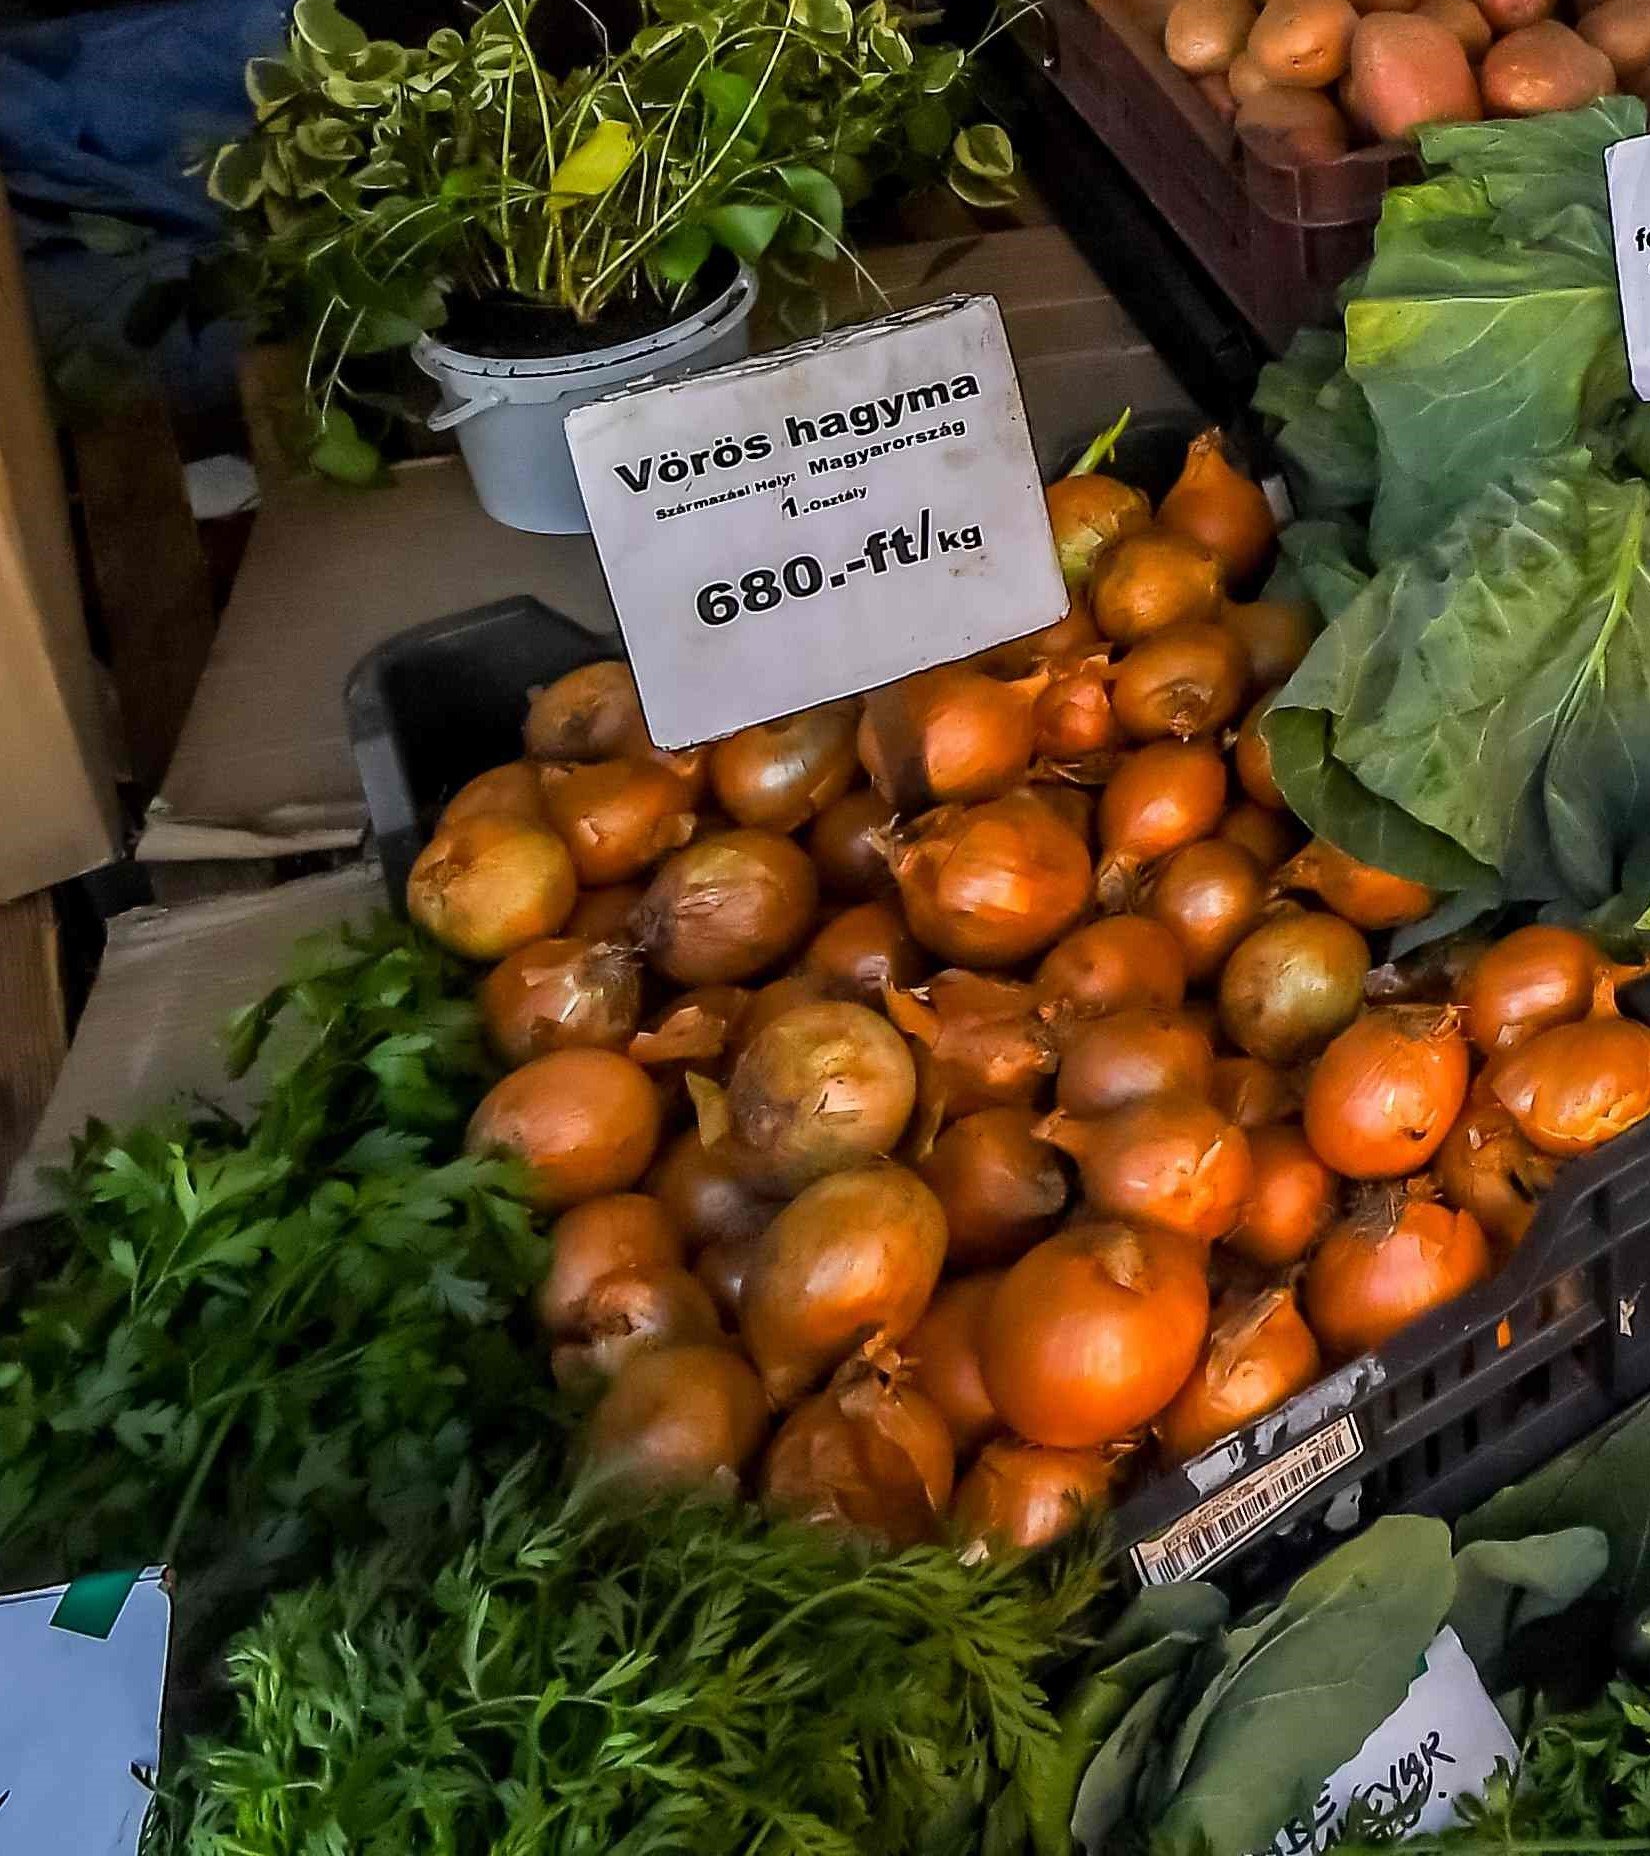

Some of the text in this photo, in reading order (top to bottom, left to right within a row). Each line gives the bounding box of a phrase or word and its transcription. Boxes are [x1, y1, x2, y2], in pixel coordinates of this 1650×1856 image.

[614, 373, 981, 494] Vörös hagyma
[655, 485, 751, 520] Származási
[808, 419, 967, 476] Magyarország
[696, 509, 983, 627] 680.-ft/kg
